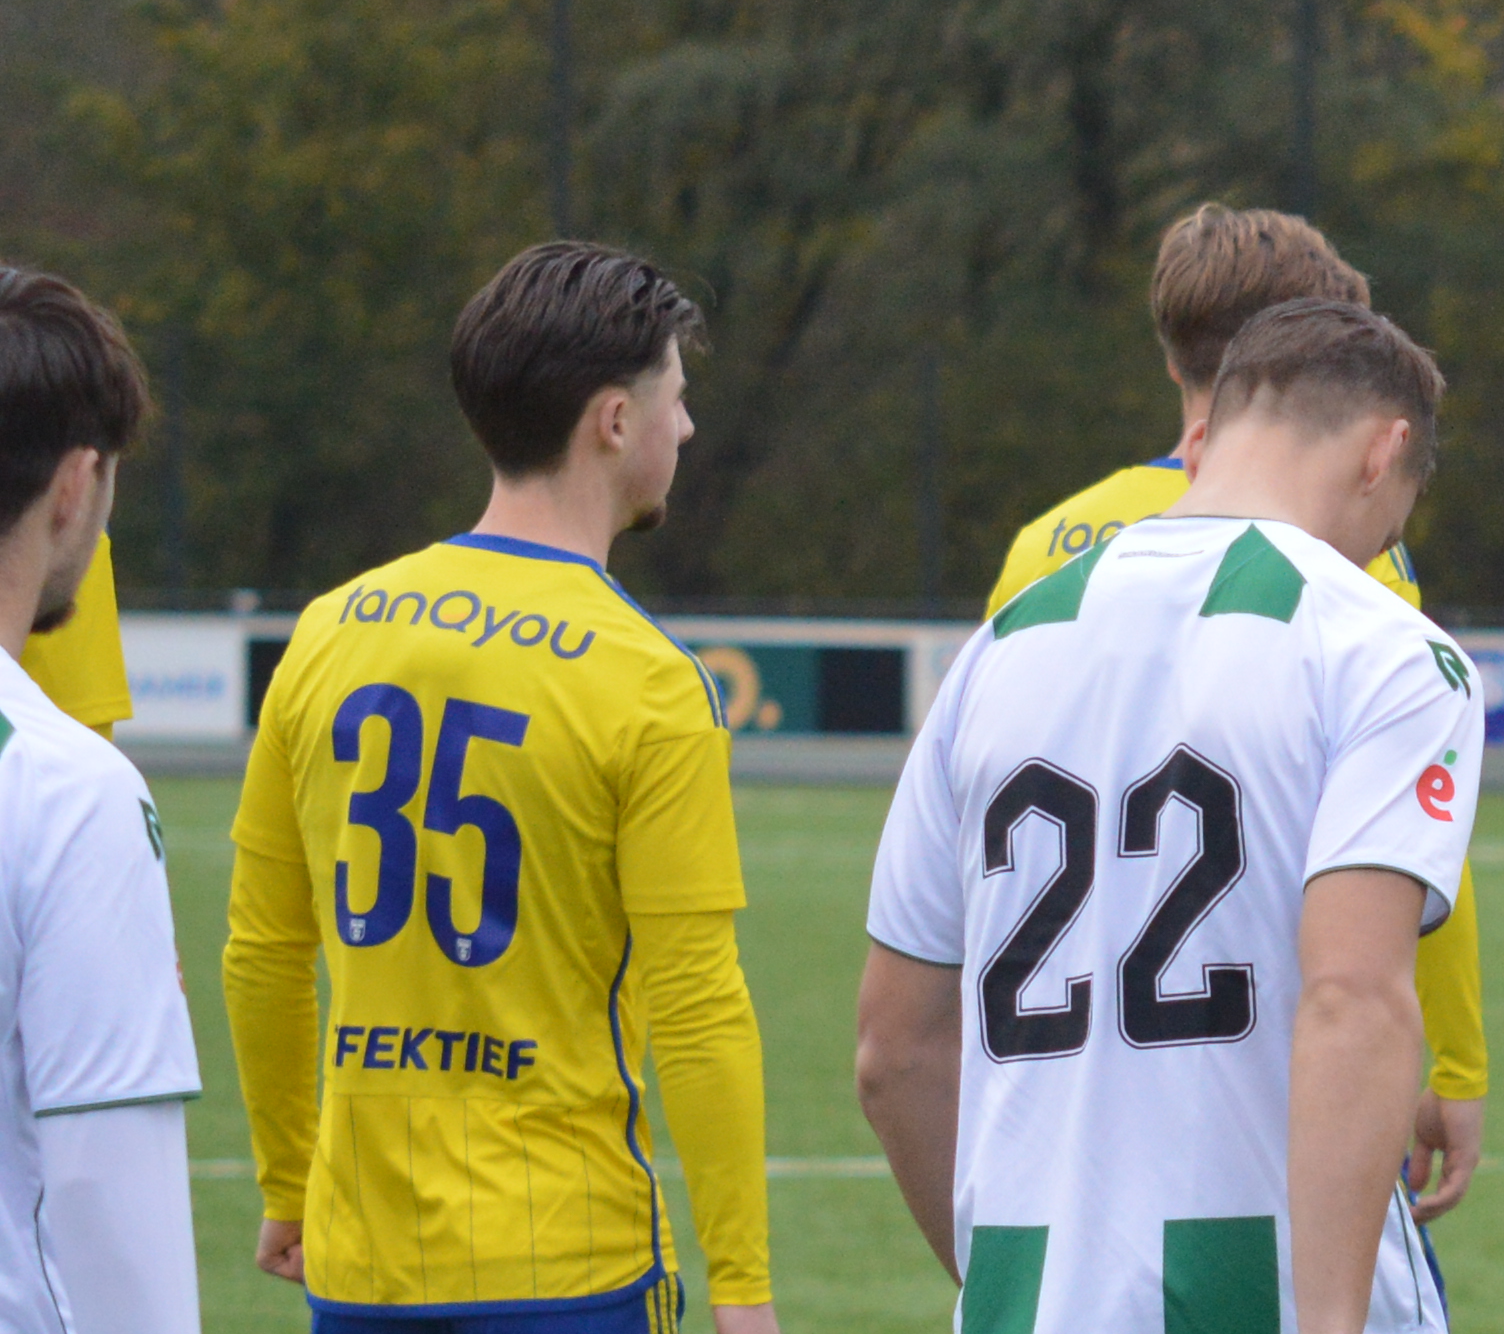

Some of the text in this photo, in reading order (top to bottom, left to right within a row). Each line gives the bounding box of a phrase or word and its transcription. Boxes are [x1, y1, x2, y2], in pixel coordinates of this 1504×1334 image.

[338, 584, 597, 660] tanQyou
[332, 683, 529, 968] 35
[979, 743, 1255, 1064] 22
[333, 1025, 538, 1080] FEKTIEF
